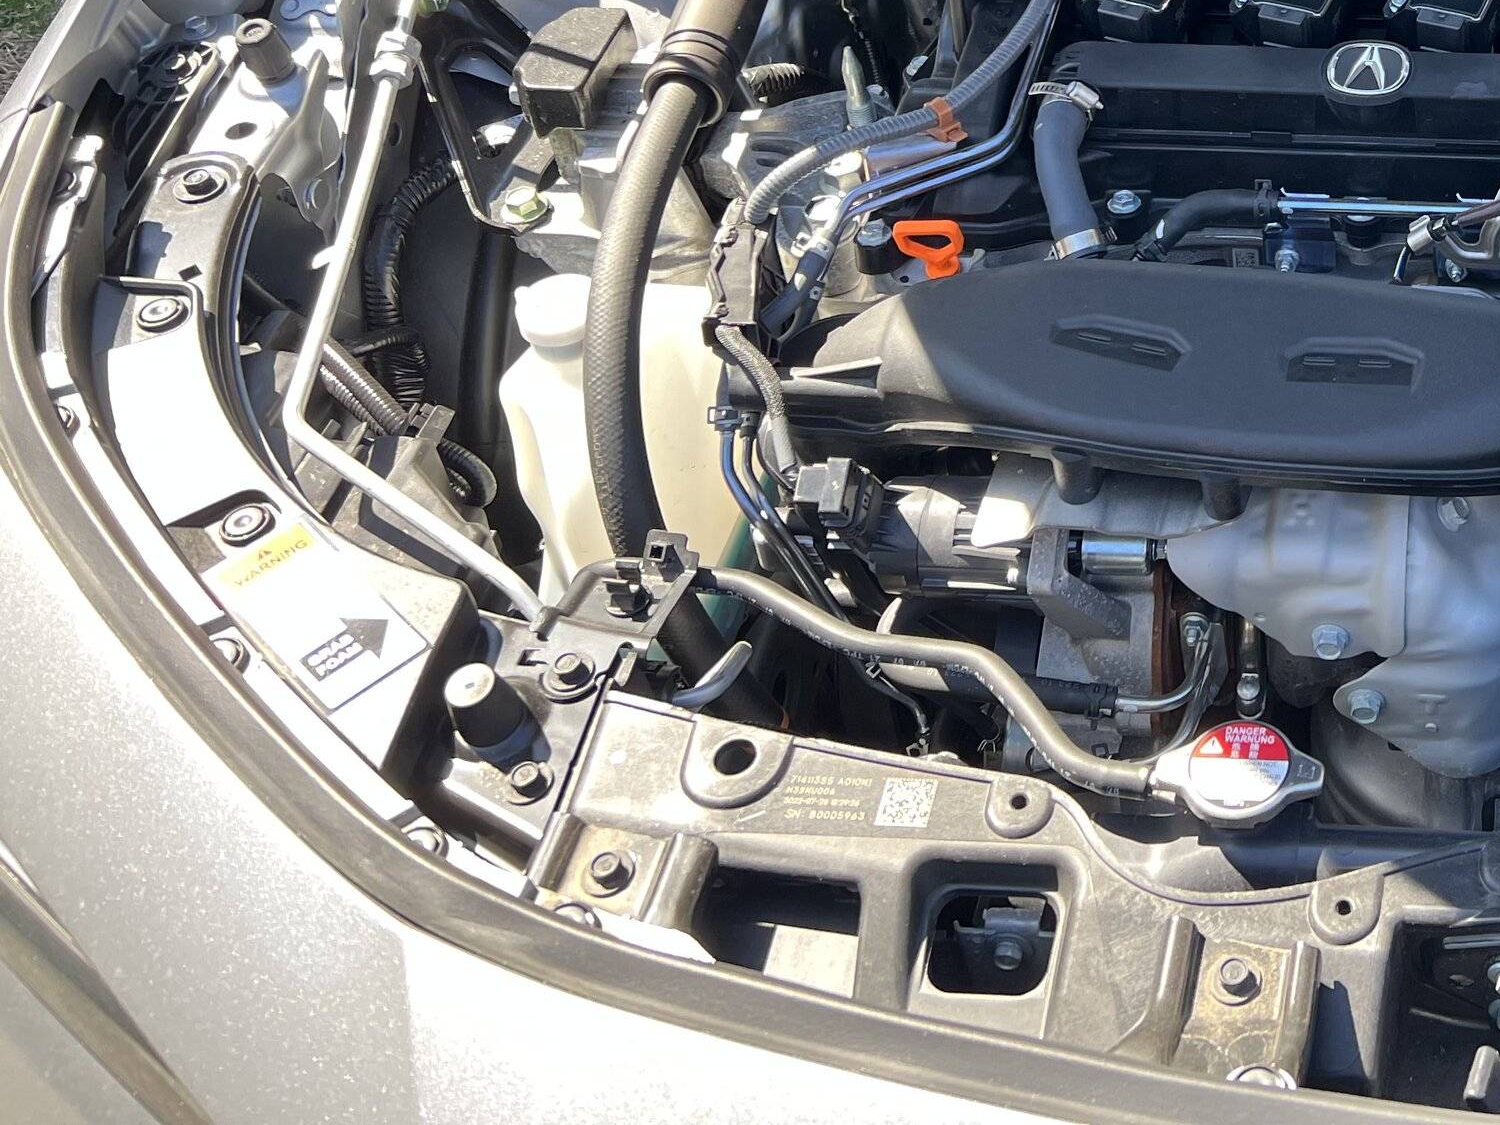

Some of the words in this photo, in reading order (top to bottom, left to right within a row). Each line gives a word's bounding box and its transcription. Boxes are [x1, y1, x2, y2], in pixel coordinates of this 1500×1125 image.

[235, 540, 307, 586] WARNING
[1226, 726, 1267, 736] DANGER
[1225, 734, 1275, 745] WARNUNG
